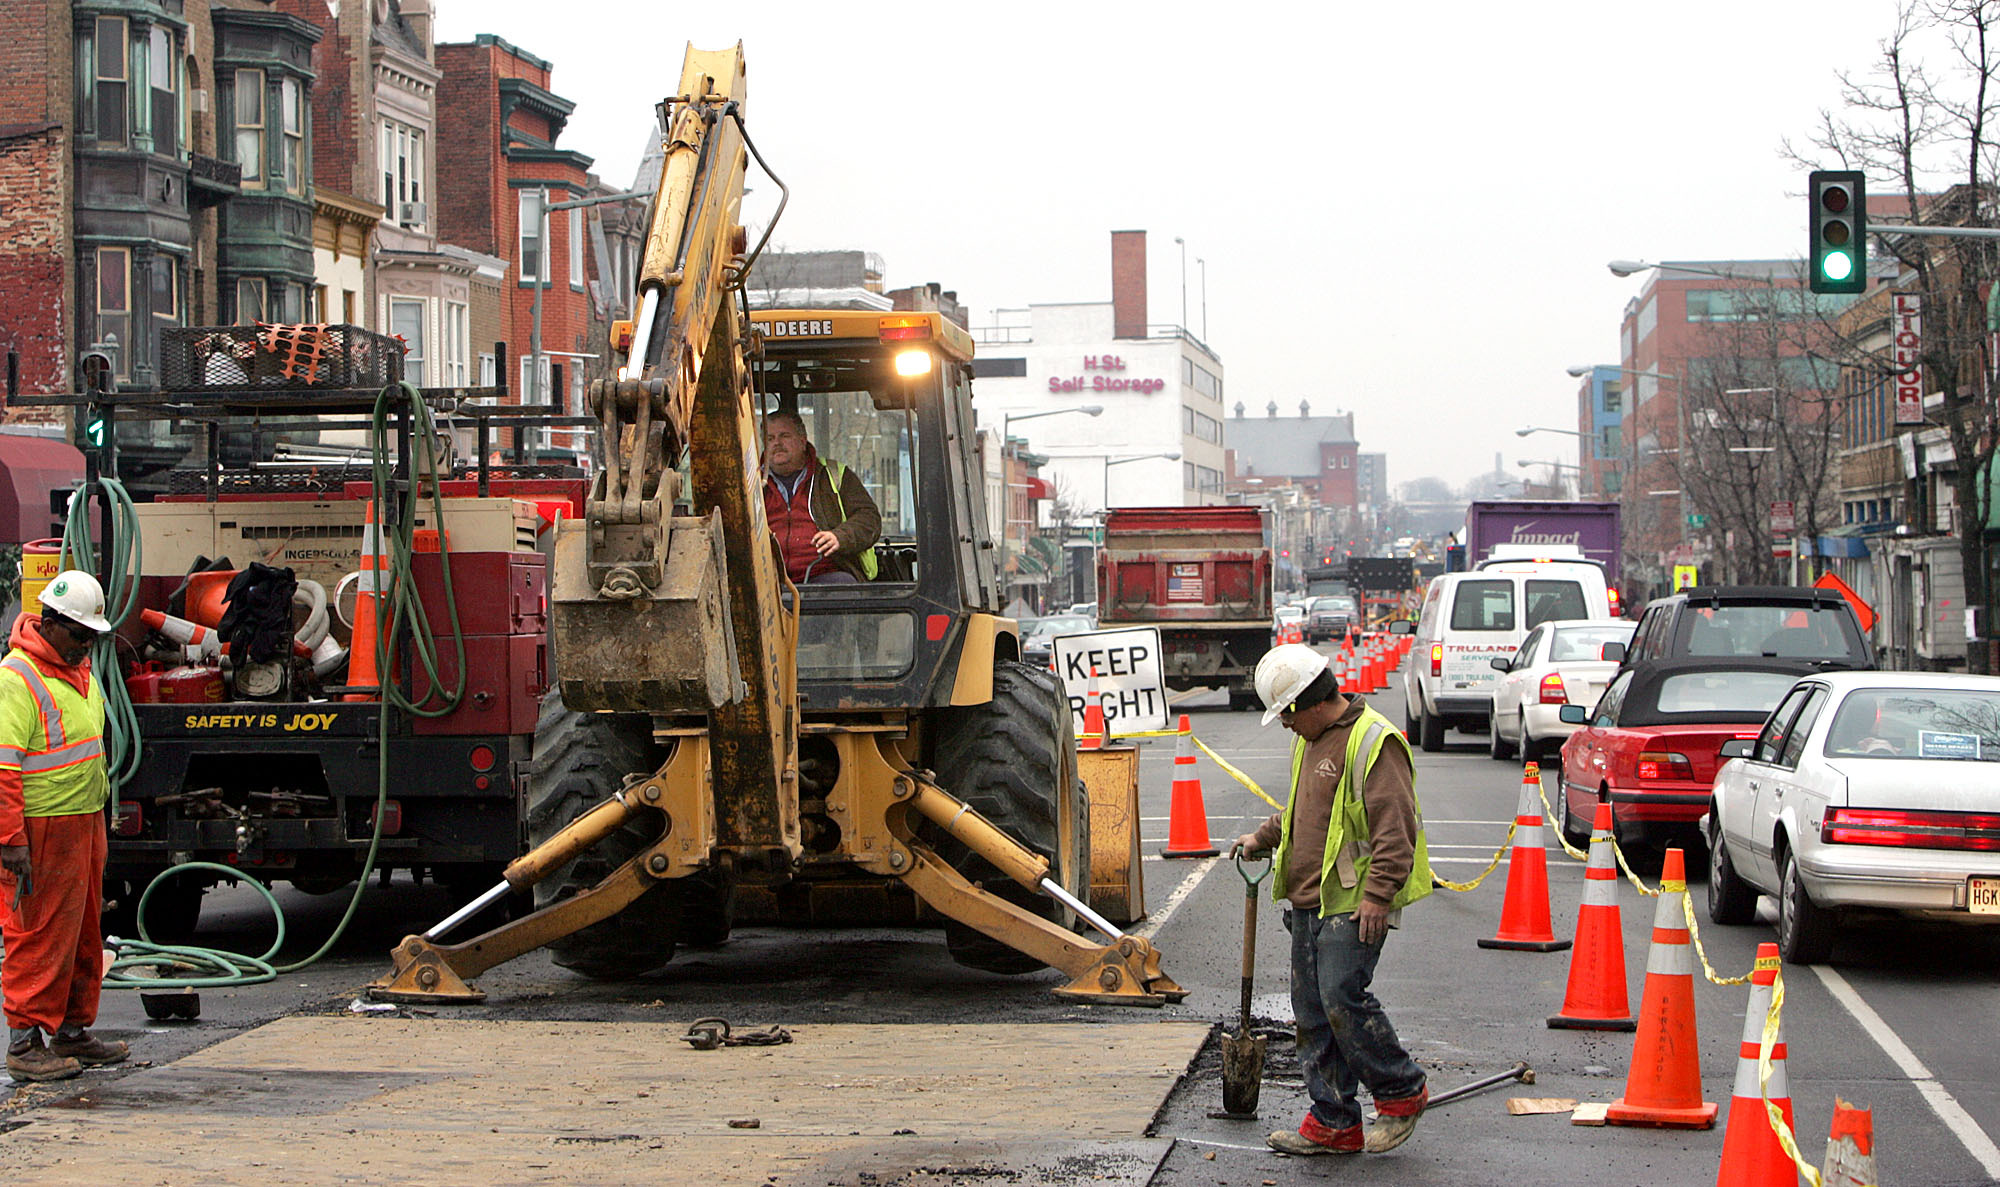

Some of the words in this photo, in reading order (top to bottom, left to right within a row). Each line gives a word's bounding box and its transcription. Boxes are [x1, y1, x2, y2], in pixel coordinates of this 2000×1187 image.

[775, 320, 833, 336] DEERE
[1896, 296, 1920, 403] LIQUOR
[1084, 355, 1097, 370] H
[1049, 376, 1084, 392] Self
[1093, 376, 1164, 395] Storage
[37, 561, 59, 576] iglo
[1066, 646, 1148, 680] KEEP
[1068, 687, 1156, 721] RGHT
[185, 715, 256, 728] SAFETY
[259, 714, 278, 727] IS
[284, 713, 338, 731] JOY
